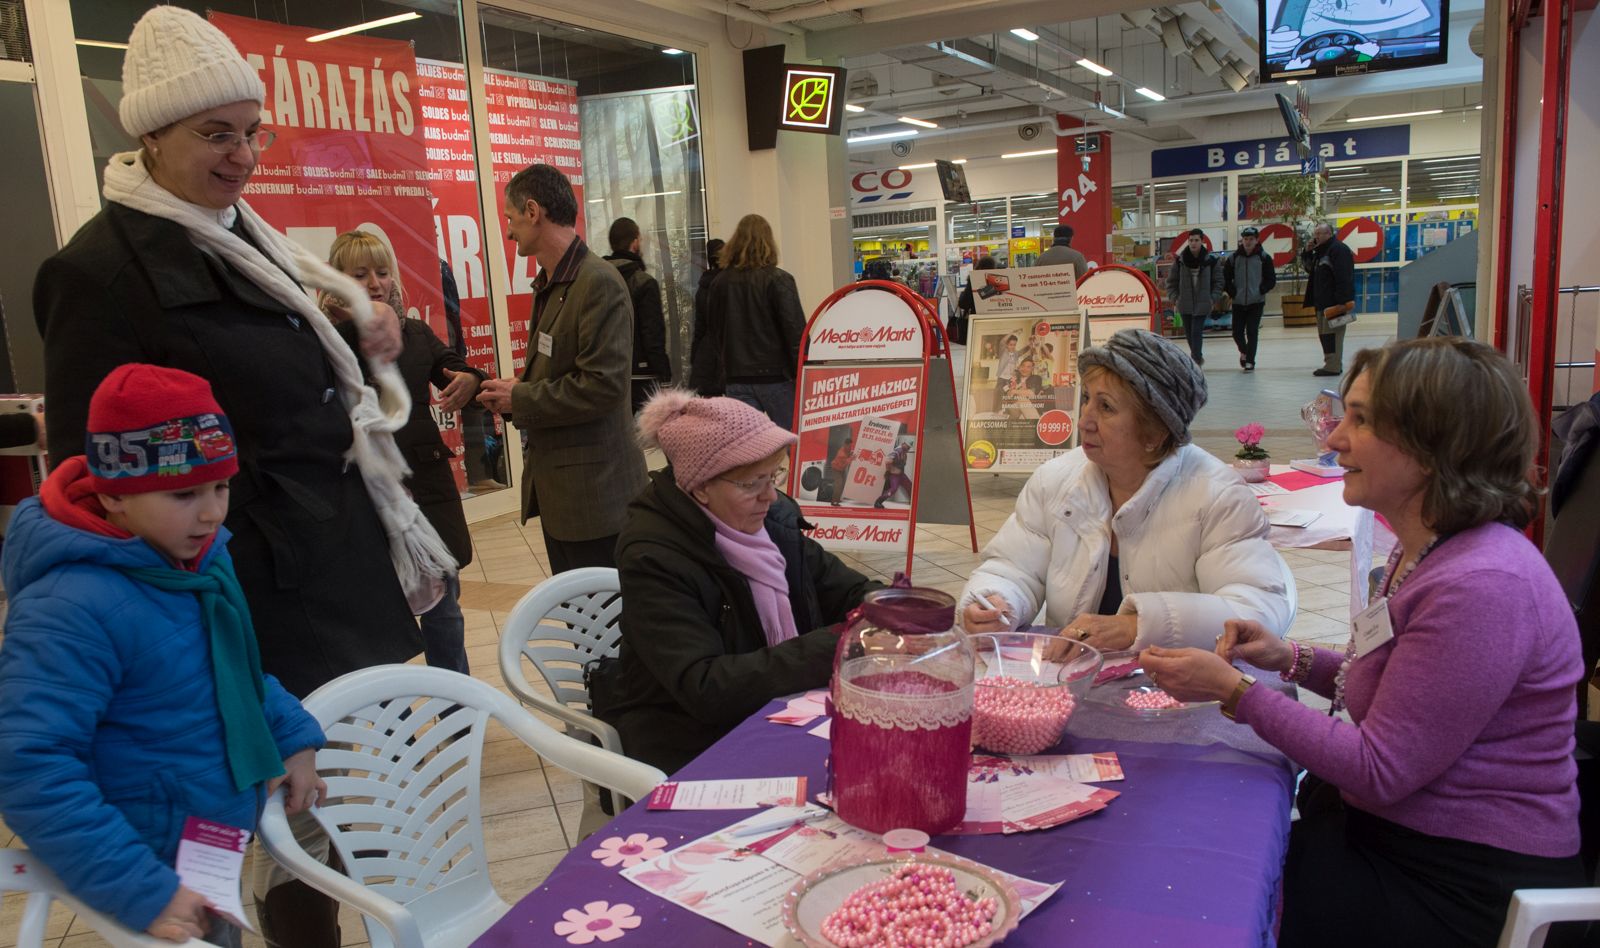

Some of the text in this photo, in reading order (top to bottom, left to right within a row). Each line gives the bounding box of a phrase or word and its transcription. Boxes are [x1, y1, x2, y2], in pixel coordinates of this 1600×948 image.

[484, 73, 495, 87] ALE
[246, 44, 415, 137] EÁRAZÁS
[418, 84, 434, 98] dmil
[422, 105, 449, 121] SOLDES
[489, 112, 505, 126] SALE
[506, 115, 531, 128] budmil
[540, 118, 558, 131] SLEVA
[1207, 137, 1357, 168] Bejáat
[263, 164, 291, 177] budmil
[303, 166, 330, 178] SOLDES
[330, 168, 355, 179] budmil
[366, 168, 382, 180] SALE
[382, 170, 406, 181] budmil
[852, 169, 912, 192] CO
[241, 182, 295, 195] USSVERKAUF
[297, 185, 324, 196] budmil
[358, 186, 382, 197] budmil
[1077, 295, 1107, 305] Media
[1113, 293, 1144, 304] Markt
[813, 326, 917, 344] Media Markt
[470, 345, 494, 357] budm
[812, 372, 860, 395] INGYEN
[804, 376, 918, 412] SZÁLLÍTUNK HÁZHOZ
[804, 398, 914, 427] MINDEN HÁZTARTÁSI NAGYGÉPET!
[969, 421, 1008, 429] ALAPCSOMAG
[856, 525, 903, 543] Markt
